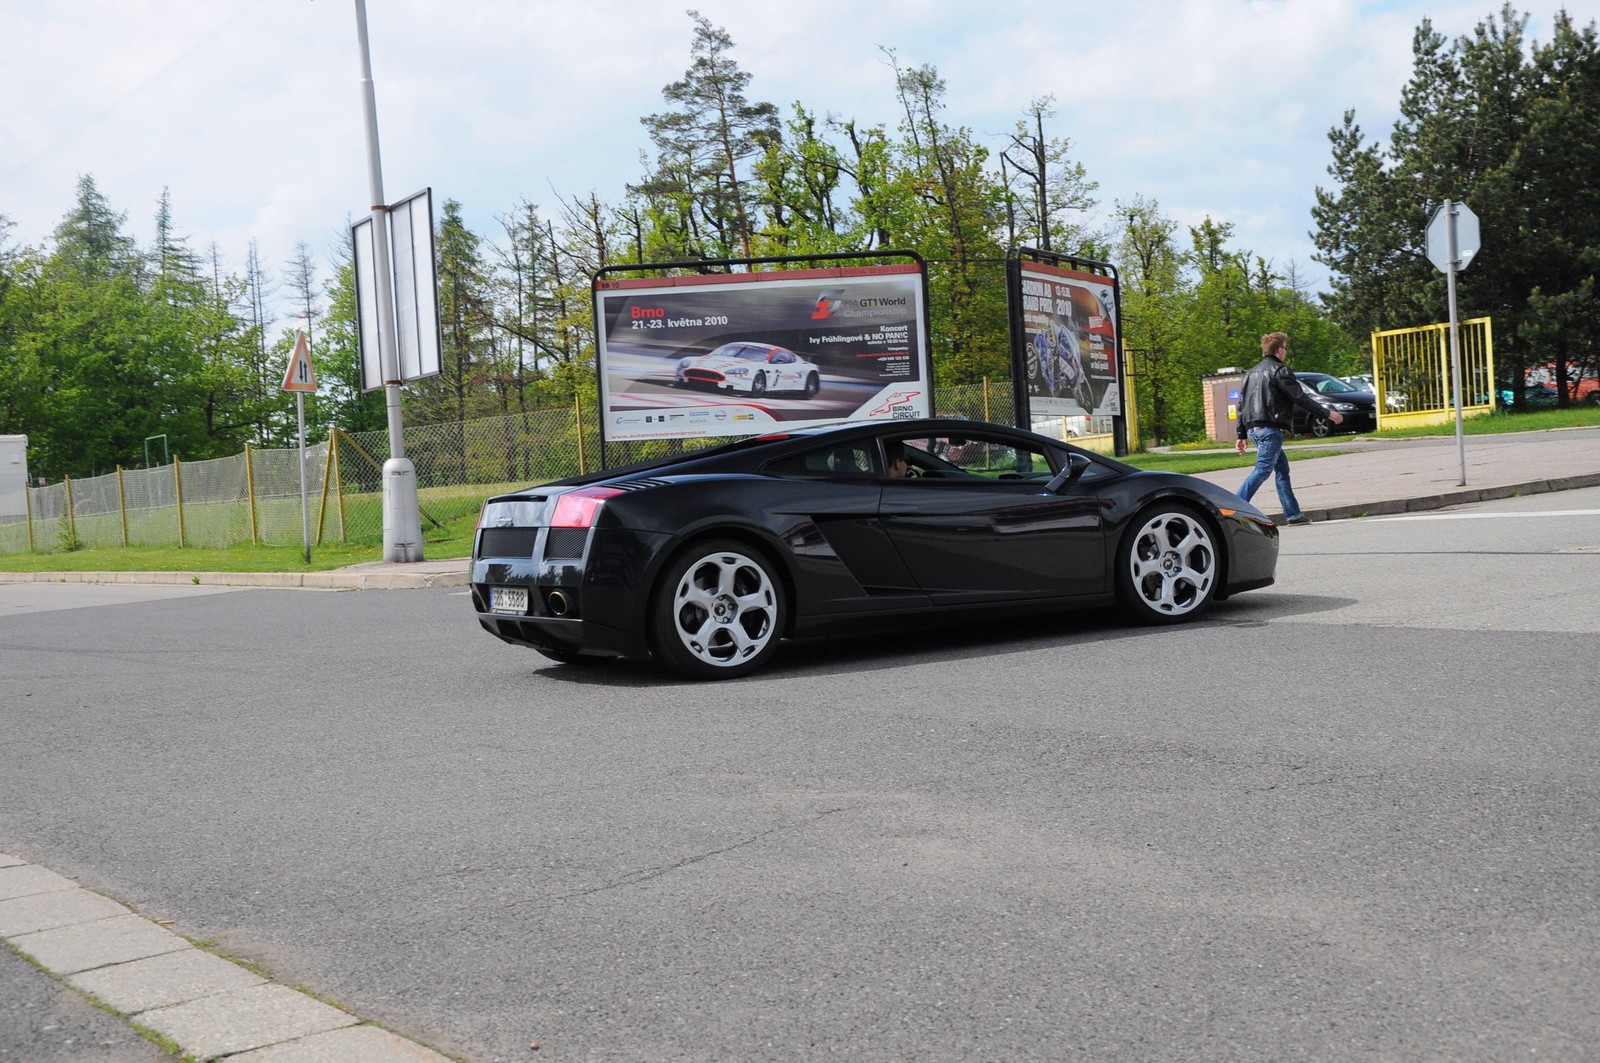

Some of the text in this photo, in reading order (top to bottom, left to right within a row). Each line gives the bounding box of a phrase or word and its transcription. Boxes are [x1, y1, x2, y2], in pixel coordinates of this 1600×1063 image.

[860, 299, 878, 307] GT1
[880, 297, 907, 306] World
[1023, 296, 1039, 311] RAND
[1056, 299, 1072, 317] 2010
[631, 306, 665, 319] Brno
[844, 307, 907, 318] Championship
[631, 315, 728, 330] 21.-23. května 2010
[880, 325, 908, 333] Koncert
[809, 336, 821, 345] Ivy
[822, 334, 863, 344] Frühlingové
[864, 333, 871, 341] &
[872, 332, 884, 340] NO
[892, 411, 921, 419] CIRCUIT
